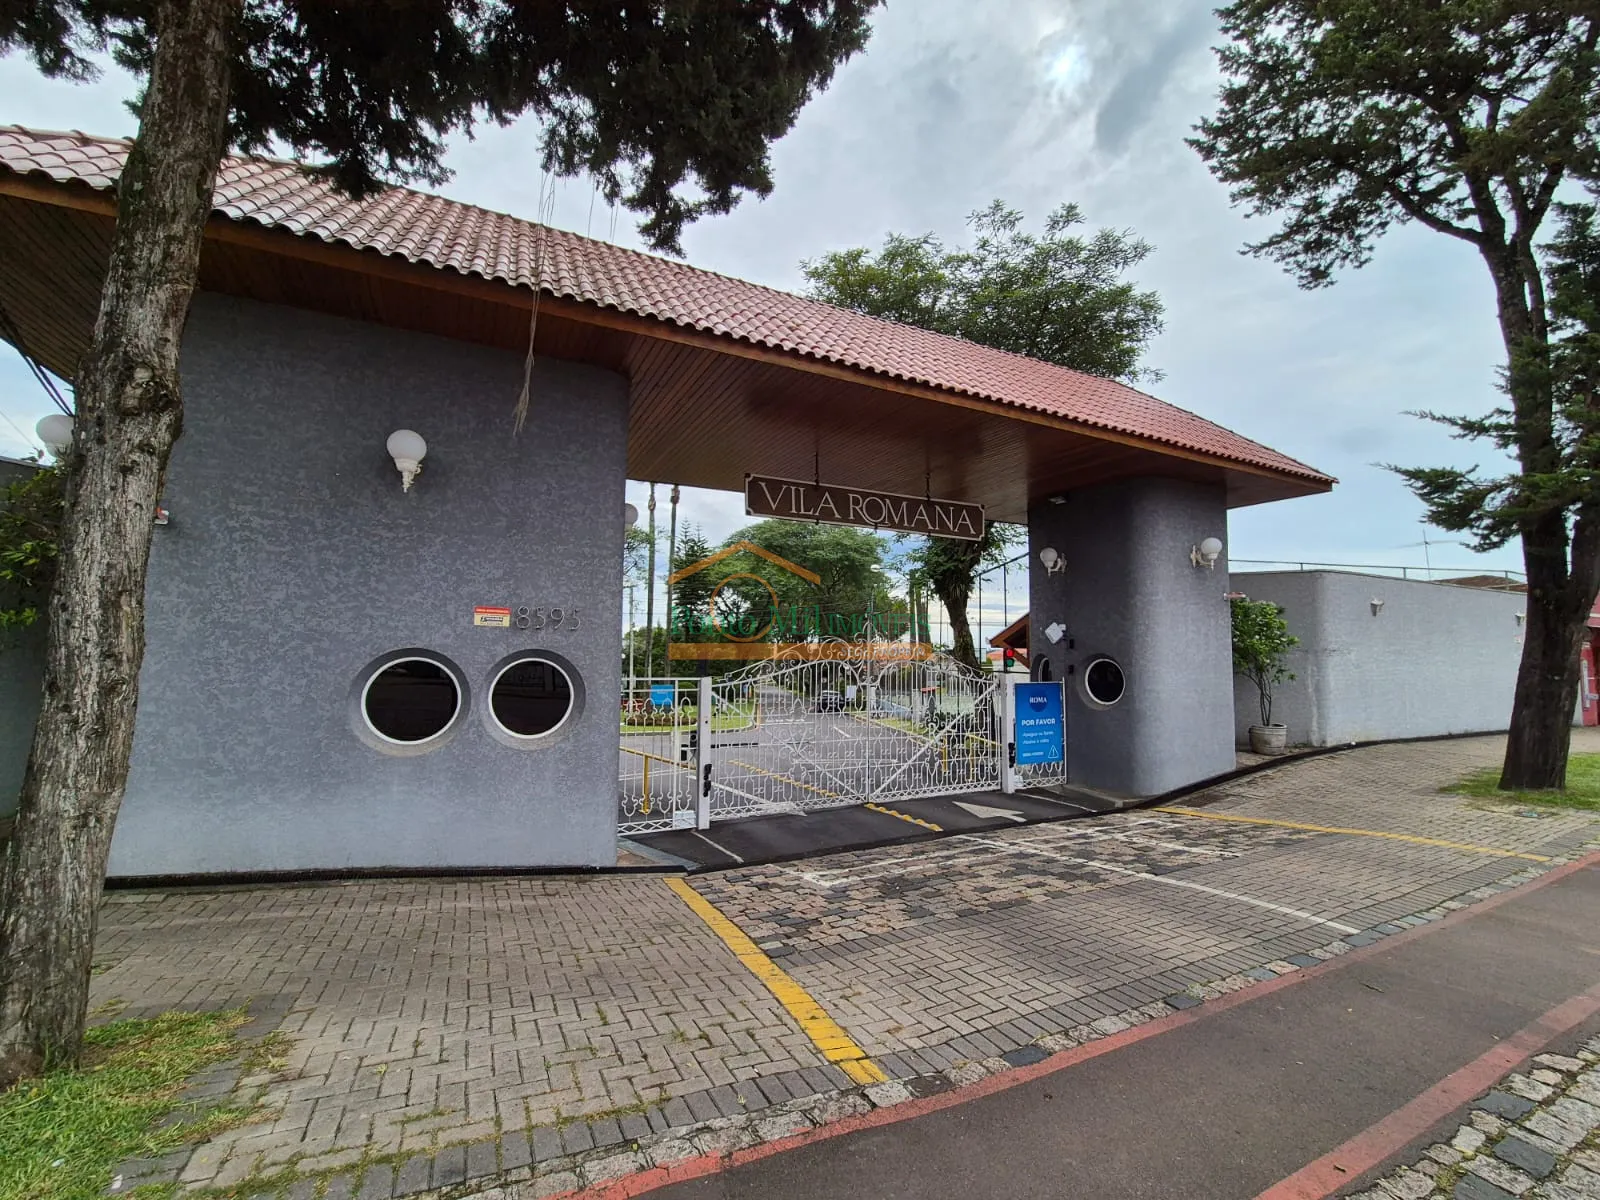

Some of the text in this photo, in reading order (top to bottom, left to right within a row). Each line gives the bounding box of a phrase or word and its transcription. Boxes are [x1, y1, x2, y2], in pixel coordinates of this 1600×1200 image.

[758, 481, 976, 535] VILA ROMANA
[516, 605, 581, 630] 8595
